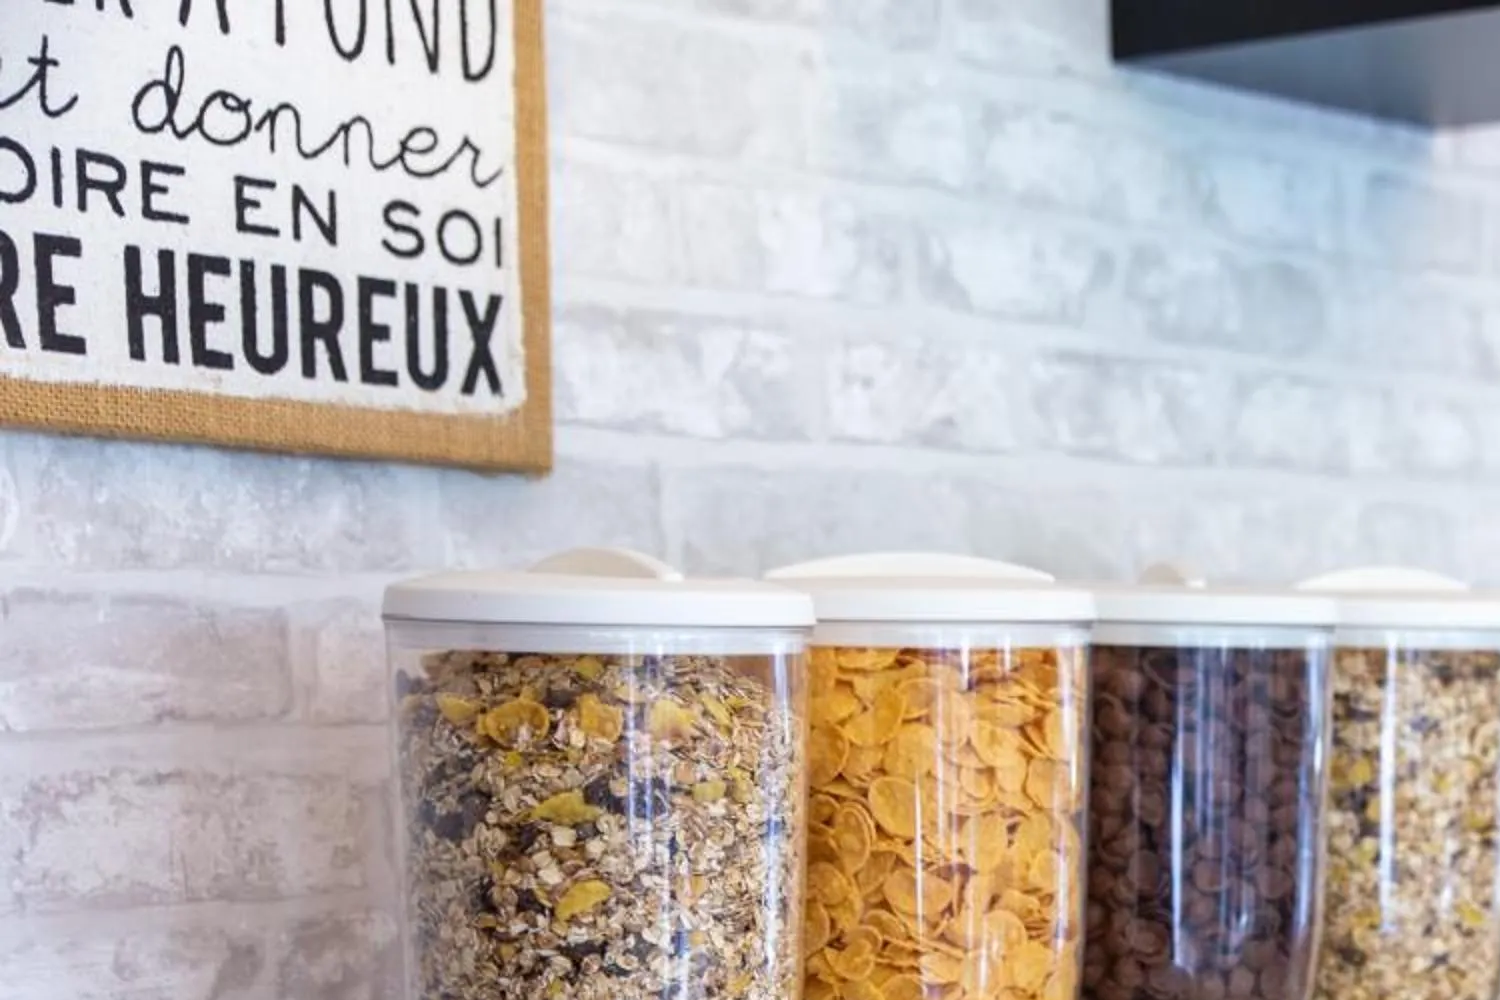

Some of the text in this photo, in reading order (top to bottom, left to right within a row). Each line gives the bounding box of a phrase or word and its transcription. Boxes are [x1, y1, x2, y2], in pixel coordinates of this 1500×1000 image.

[0, 34, 503, 188] t donner
[234, 174, 338, 246] EN
[382, 200, 502, 268] SOI
[124, 244, 504, 398] HEUREUX
